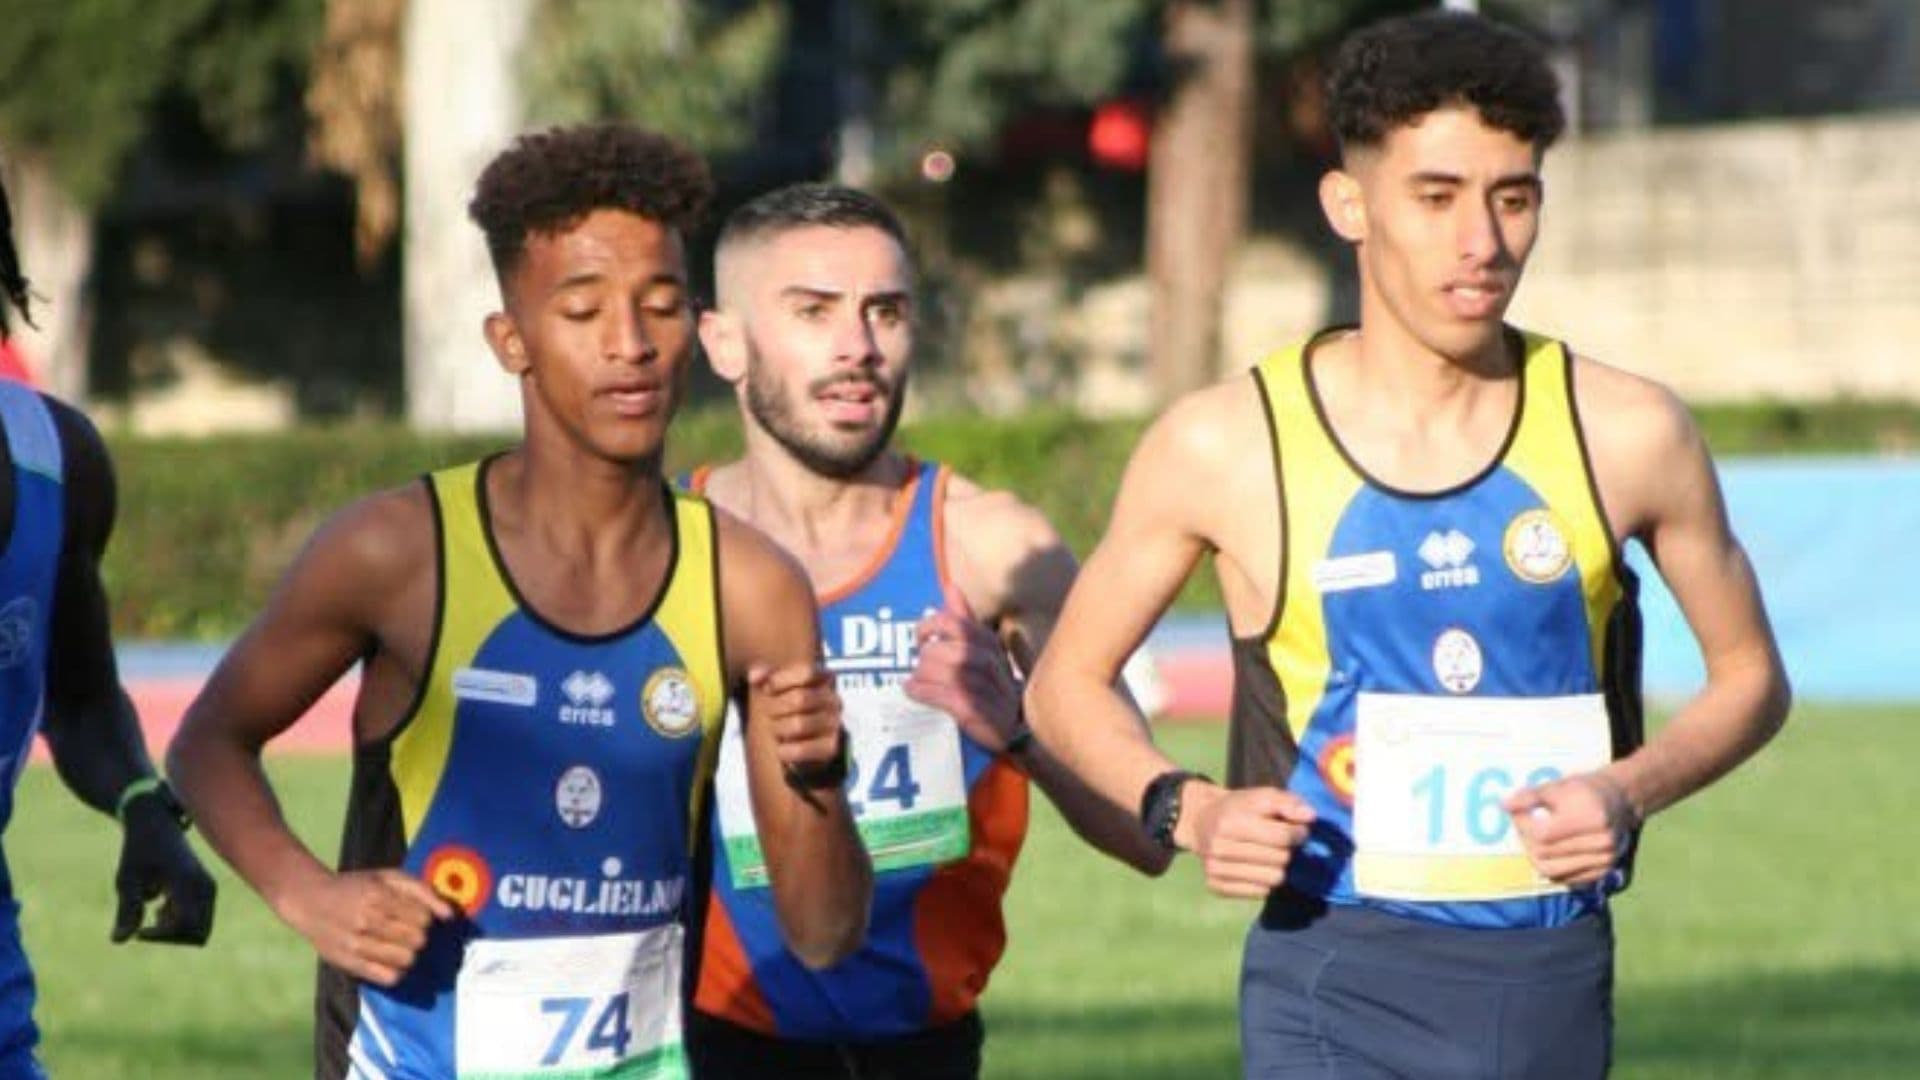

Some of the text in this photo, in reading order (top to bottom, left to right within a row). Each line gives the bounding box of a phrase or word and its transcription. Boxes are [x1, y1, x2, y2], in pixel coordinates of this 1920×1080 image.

[846, 743, 920, 815] 4
[1411, 764, 1562, 845] 16
[539, 991, 632, 1067] 74
